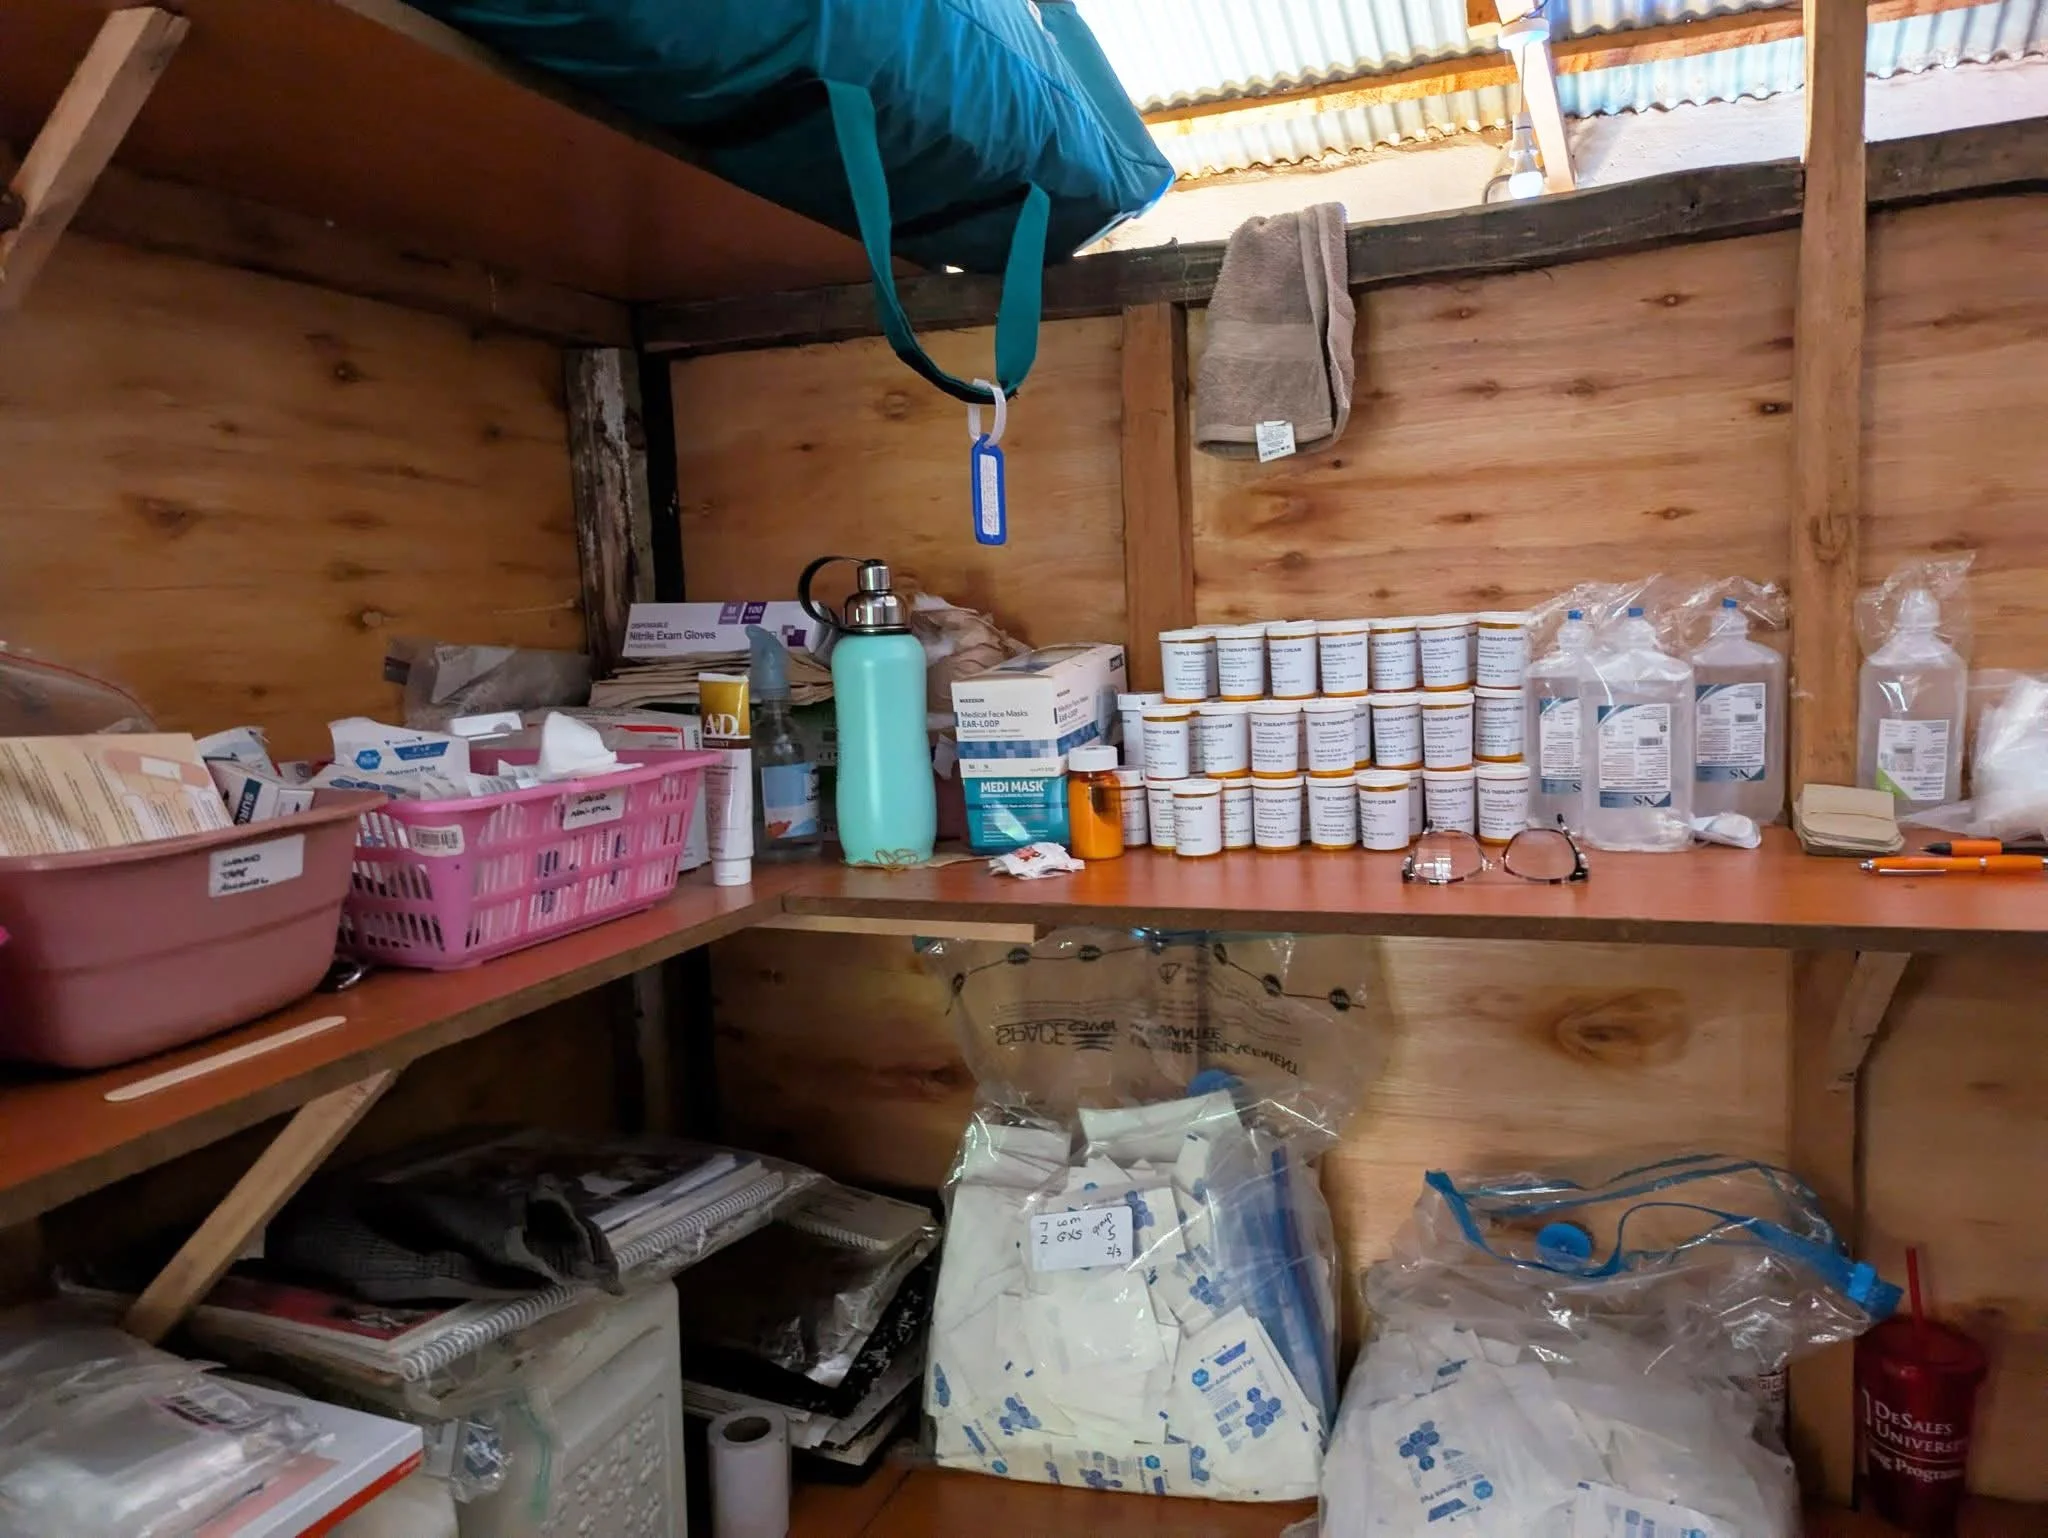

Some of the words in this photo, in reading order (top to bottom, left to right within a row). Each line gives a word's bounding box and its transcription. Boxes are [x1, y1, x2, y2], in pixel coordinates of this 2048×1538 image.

[748, 605, 763, 614] 100
[629, 631, 655, 641] Nitrile
[656, 631, 682, 641] Exam
[684, 629, 716, 640] Gloves
[989, 710, 1005, 718] Face
[961, 720, 1000, 728] EAR-LOOP
[419, 764, 436, 773] Pad
[980, 781, 1009, 793] MEDI
[1011, 780, 1044, 792] MASK
[1040, 1234, 1049, 1245] 2
